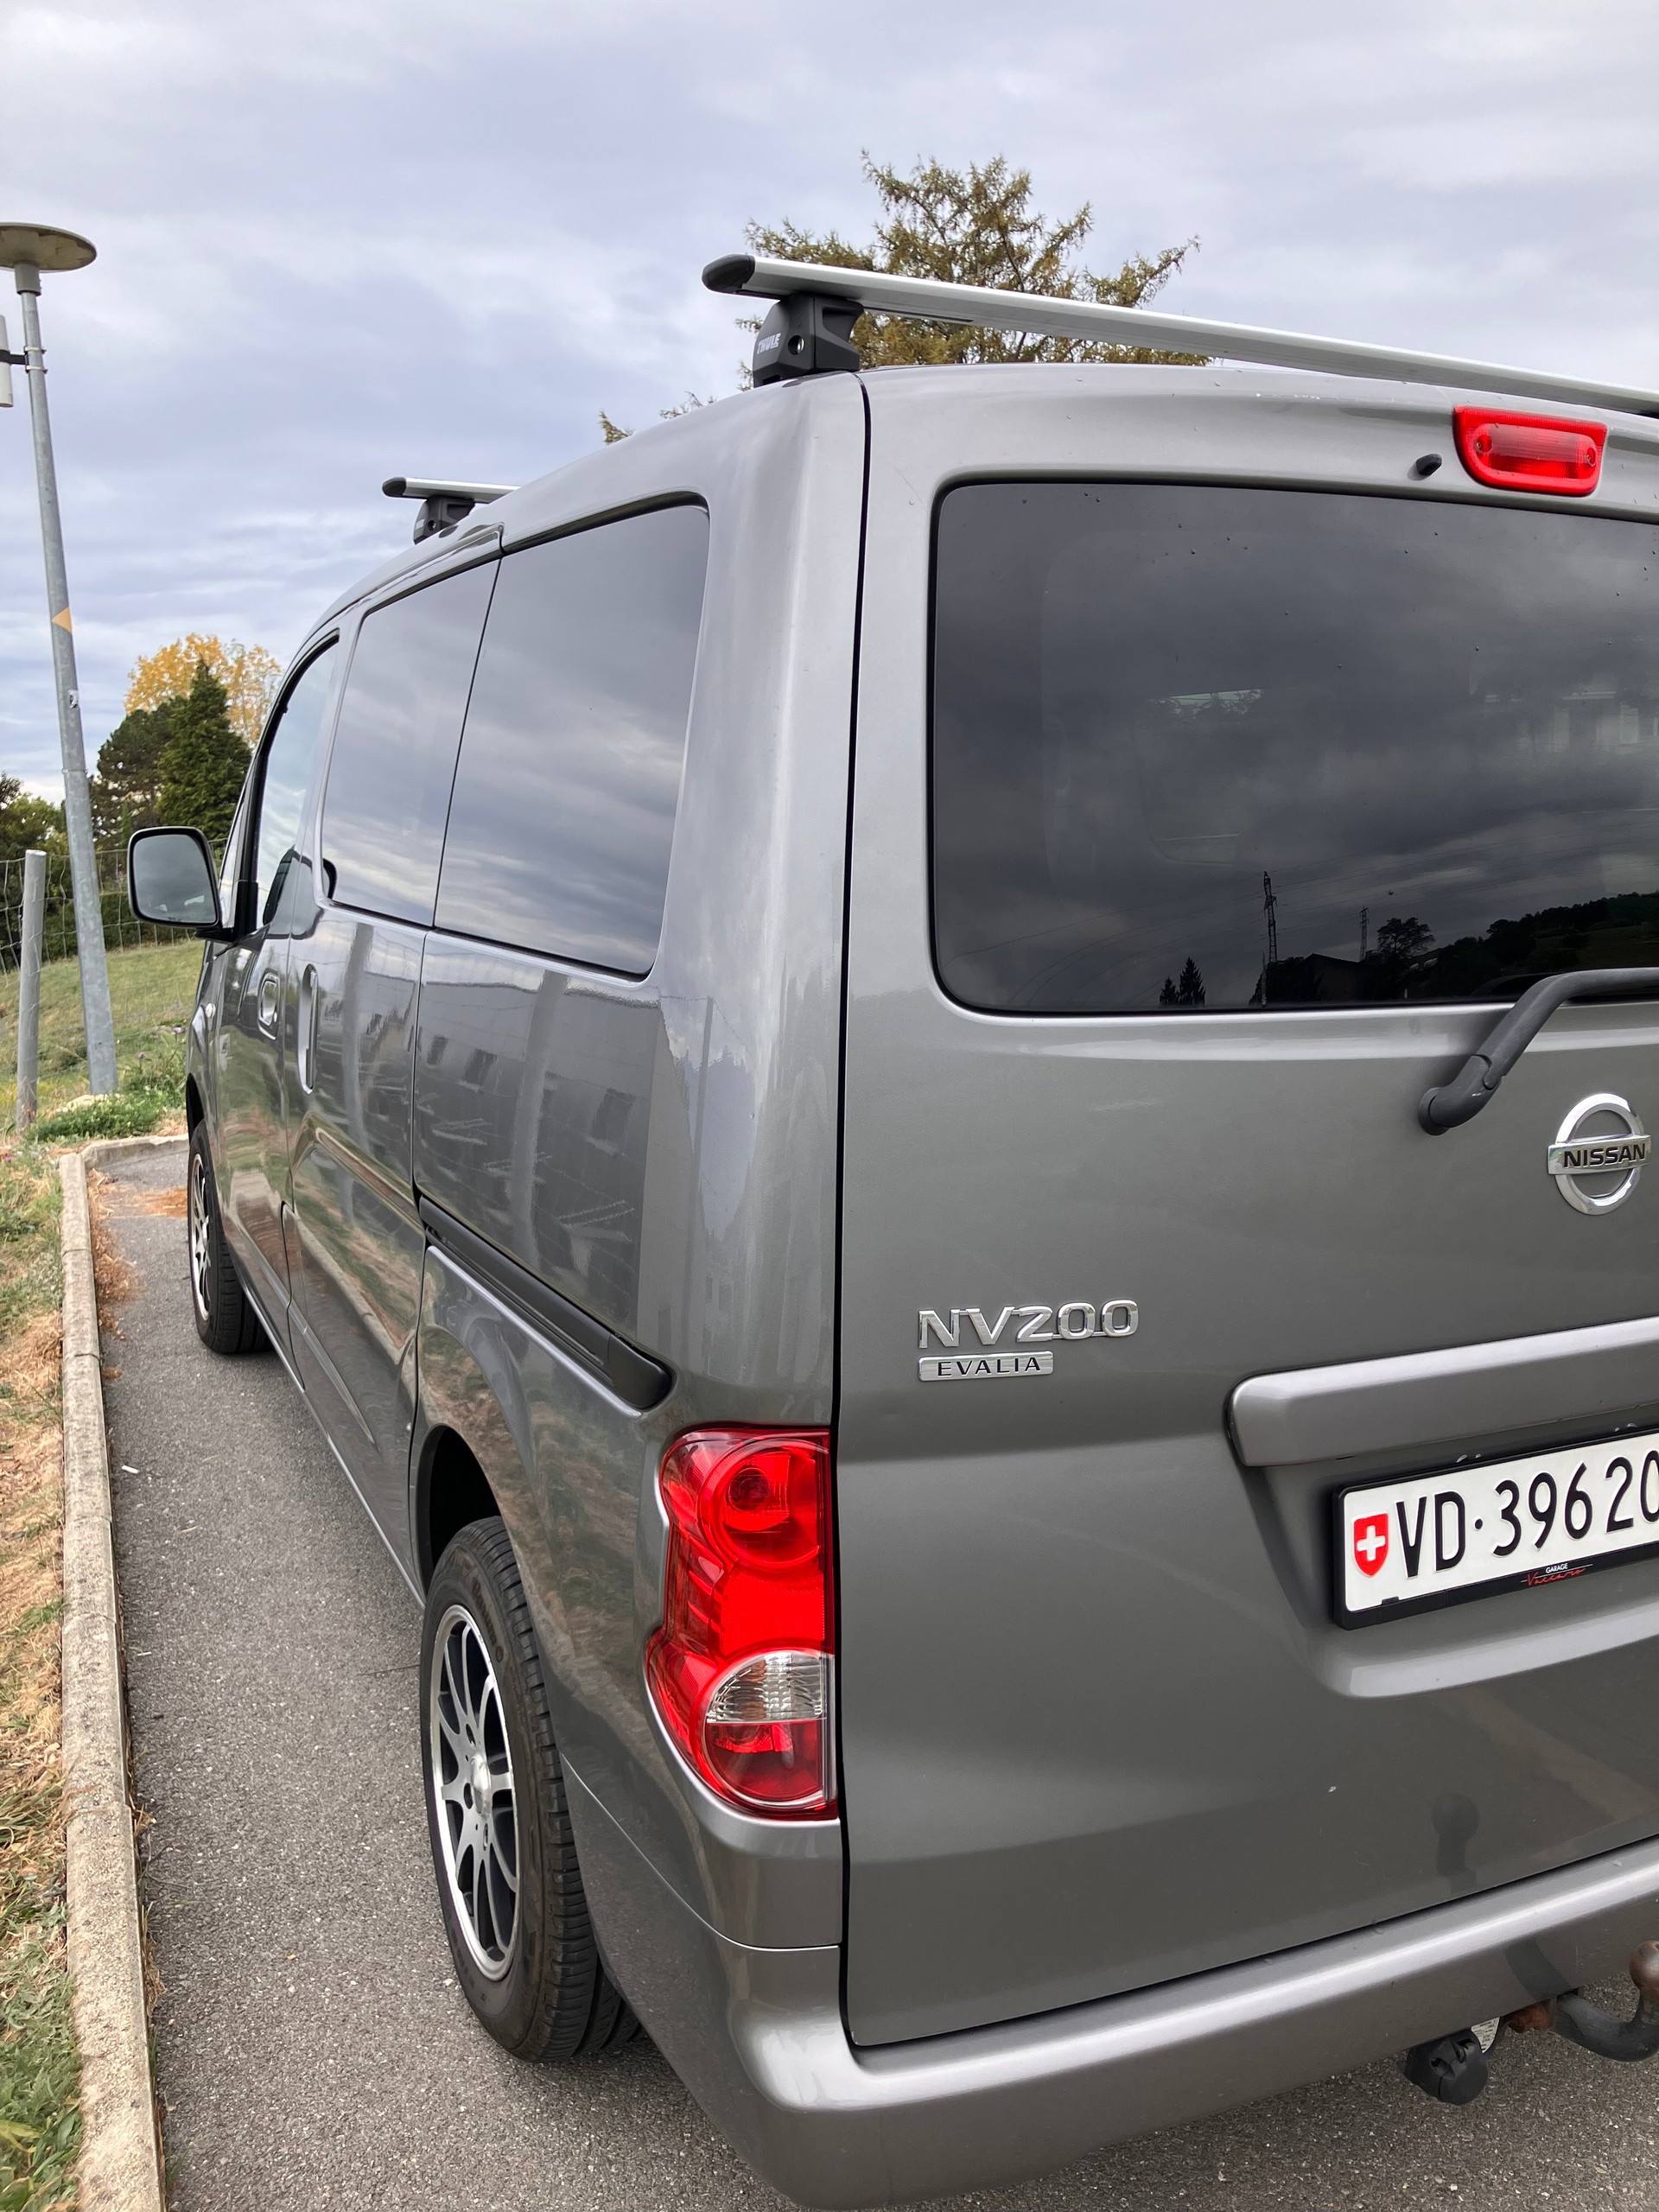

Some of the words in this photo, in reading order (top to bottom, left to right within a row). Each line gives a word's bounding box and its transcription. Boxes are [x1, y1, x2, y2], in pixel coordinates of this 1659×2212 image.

[757, 333, 782, 354] THULE
[1563, 1142, 1646, 1168] NISSAN
[918, 1299, 1140, 1349] NV200
[937, 1357, 1041, 1377] EVALIA
[1545, 1563, 1569, 1573] GARAGE
